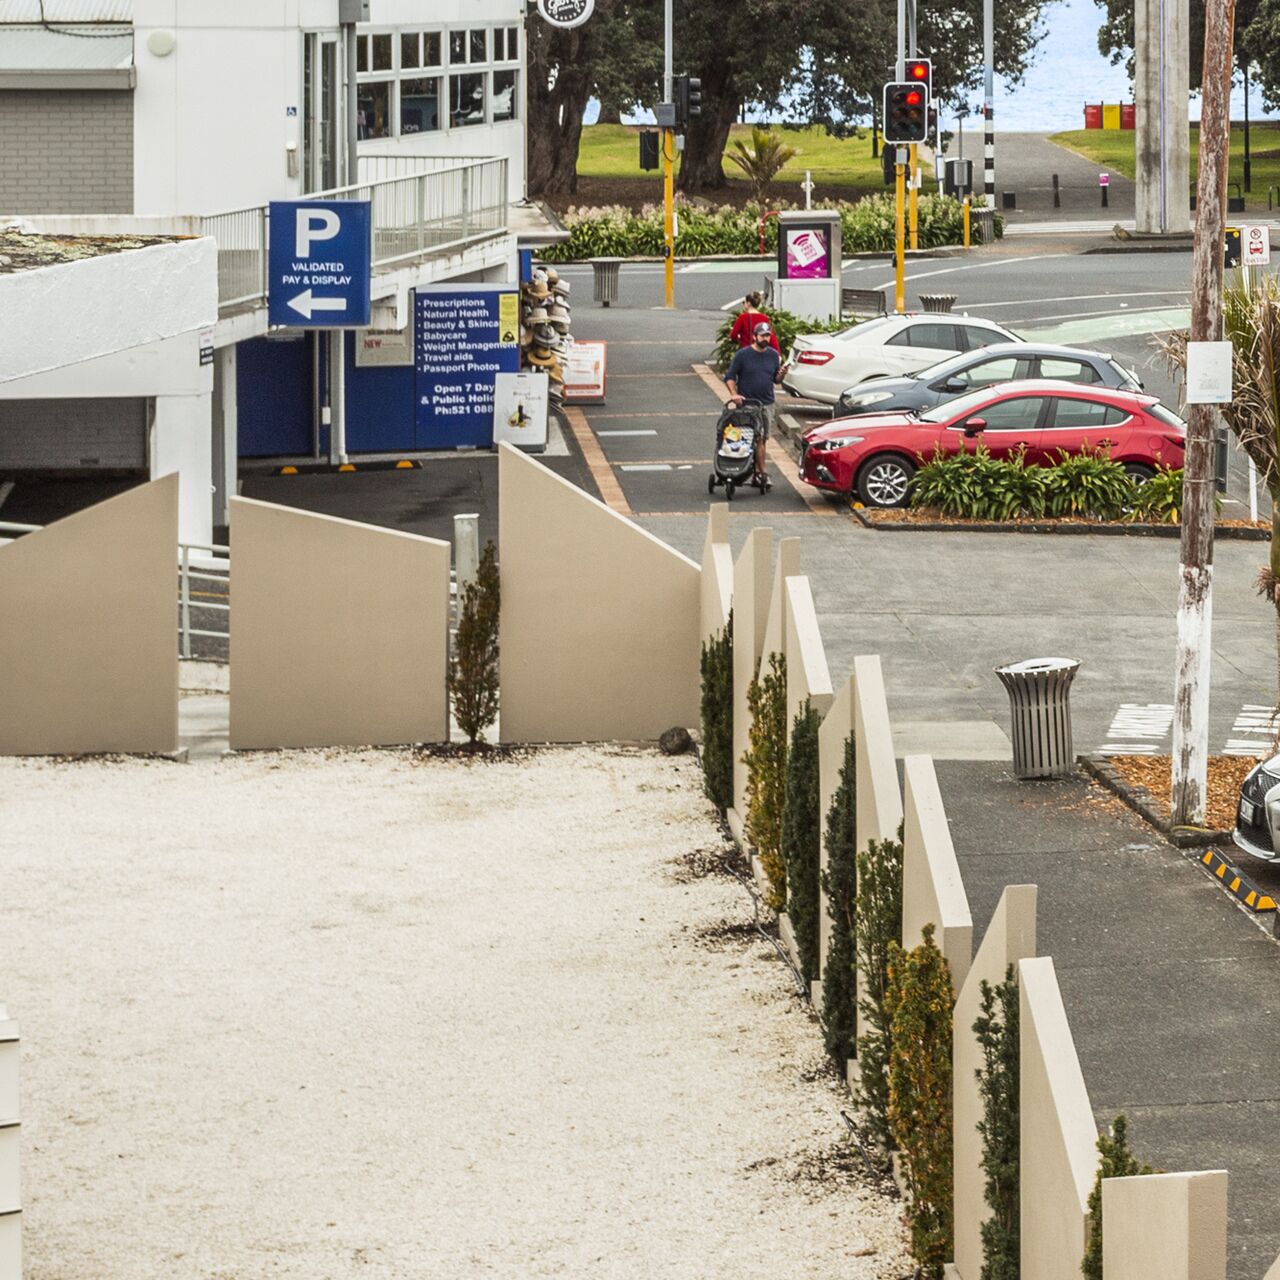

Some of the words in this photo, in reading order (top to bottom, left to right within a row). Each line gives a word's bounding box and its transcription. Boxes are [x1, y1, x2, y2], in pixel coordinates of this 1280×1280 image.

[295, 207, 341, 258] P
[291, 262, 345, 272] VALIDATED
[282, 275, 301, 285] PAY
[302, 275, 310, 285] &
[311, 275, 352, 285] DISPLAY
[423, 299, 485, 308] Prescriptions
[423, 310, 457, 319] Natural
[459, 309, 489, 318] Health
[423, 321, 456, 330] Beauty
[458, 320, 465, 328] &
[467, 319, 500, 328] Skinca
[423, 332, 467, 341] Babycare
[363, 339, 381, 348] NEW
[423, 343, 456, 352] Weight
[458, 341, 517, 351] Management
[423, 354, 452, 362] Travel
[454, 353, 473, 361] aids
[423, 364, 465, 373] Passport
[467, 362, 500, 372] Photos
[434, 384, 462, 394] Open
[465, 383, 472, 392] 7
[474, 383, 495, 393] Day
[421, 396, 429, 405] &
[432, 395, 465, 404] Public
[435, 405, 470, 415] Ph:521
[474, 405, 494, 414] 088
